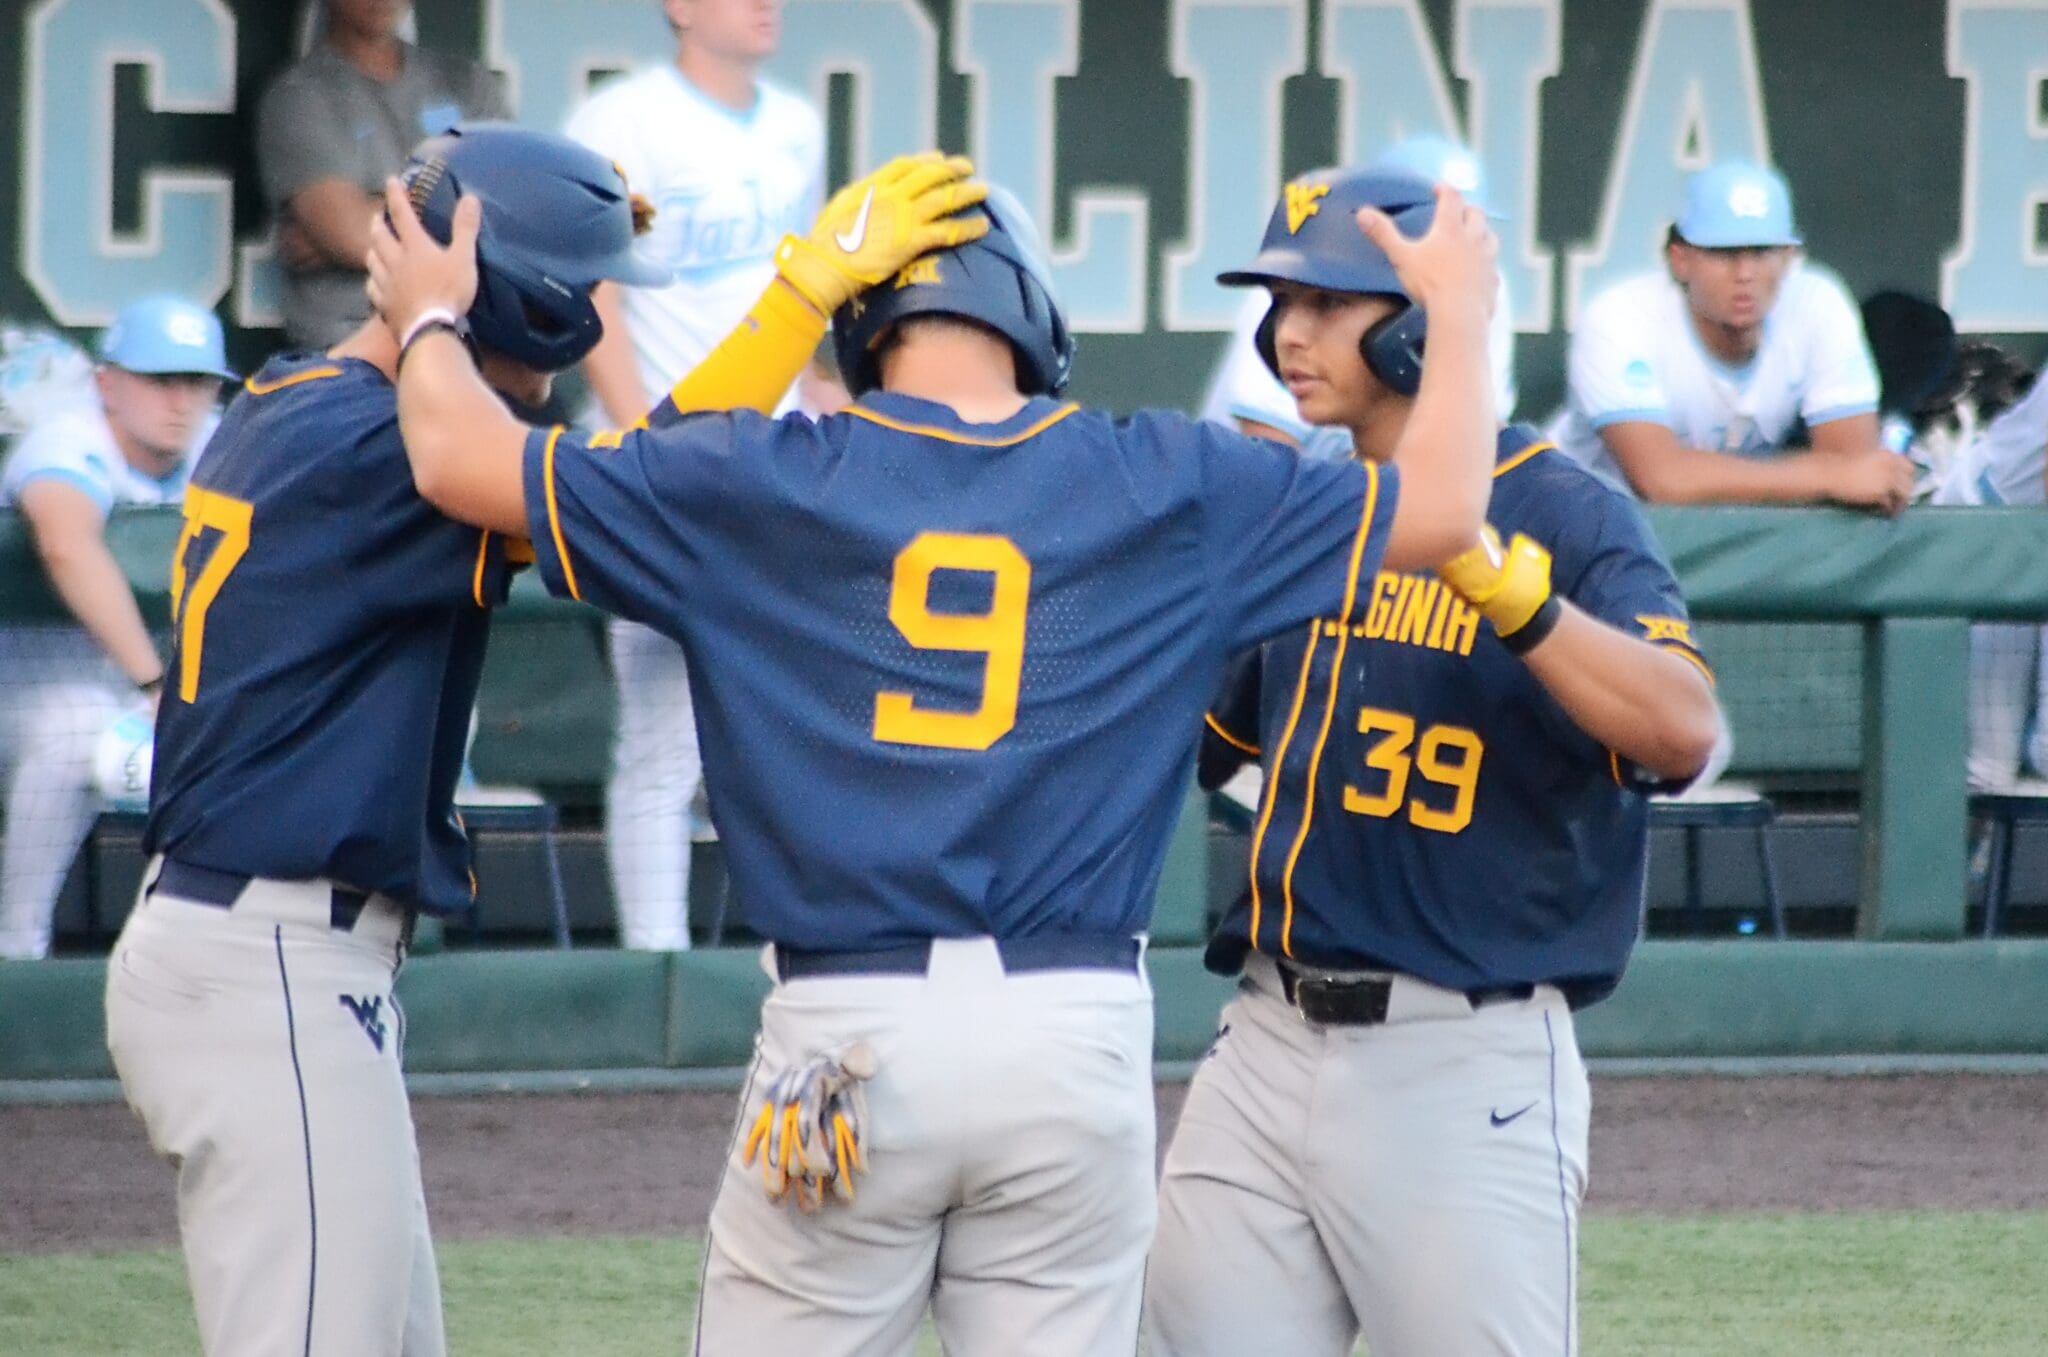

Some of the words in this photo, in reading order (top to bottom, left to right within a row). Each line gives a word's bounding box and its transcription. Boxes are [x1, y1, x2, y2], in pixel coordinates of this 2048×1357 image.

[22, 0, 1776, 333] COLINA
[872, 530, 1032, 751] 9
[1324, 569, 1481, 657] GINIA
[1342, 706, 1485, 835] 39
